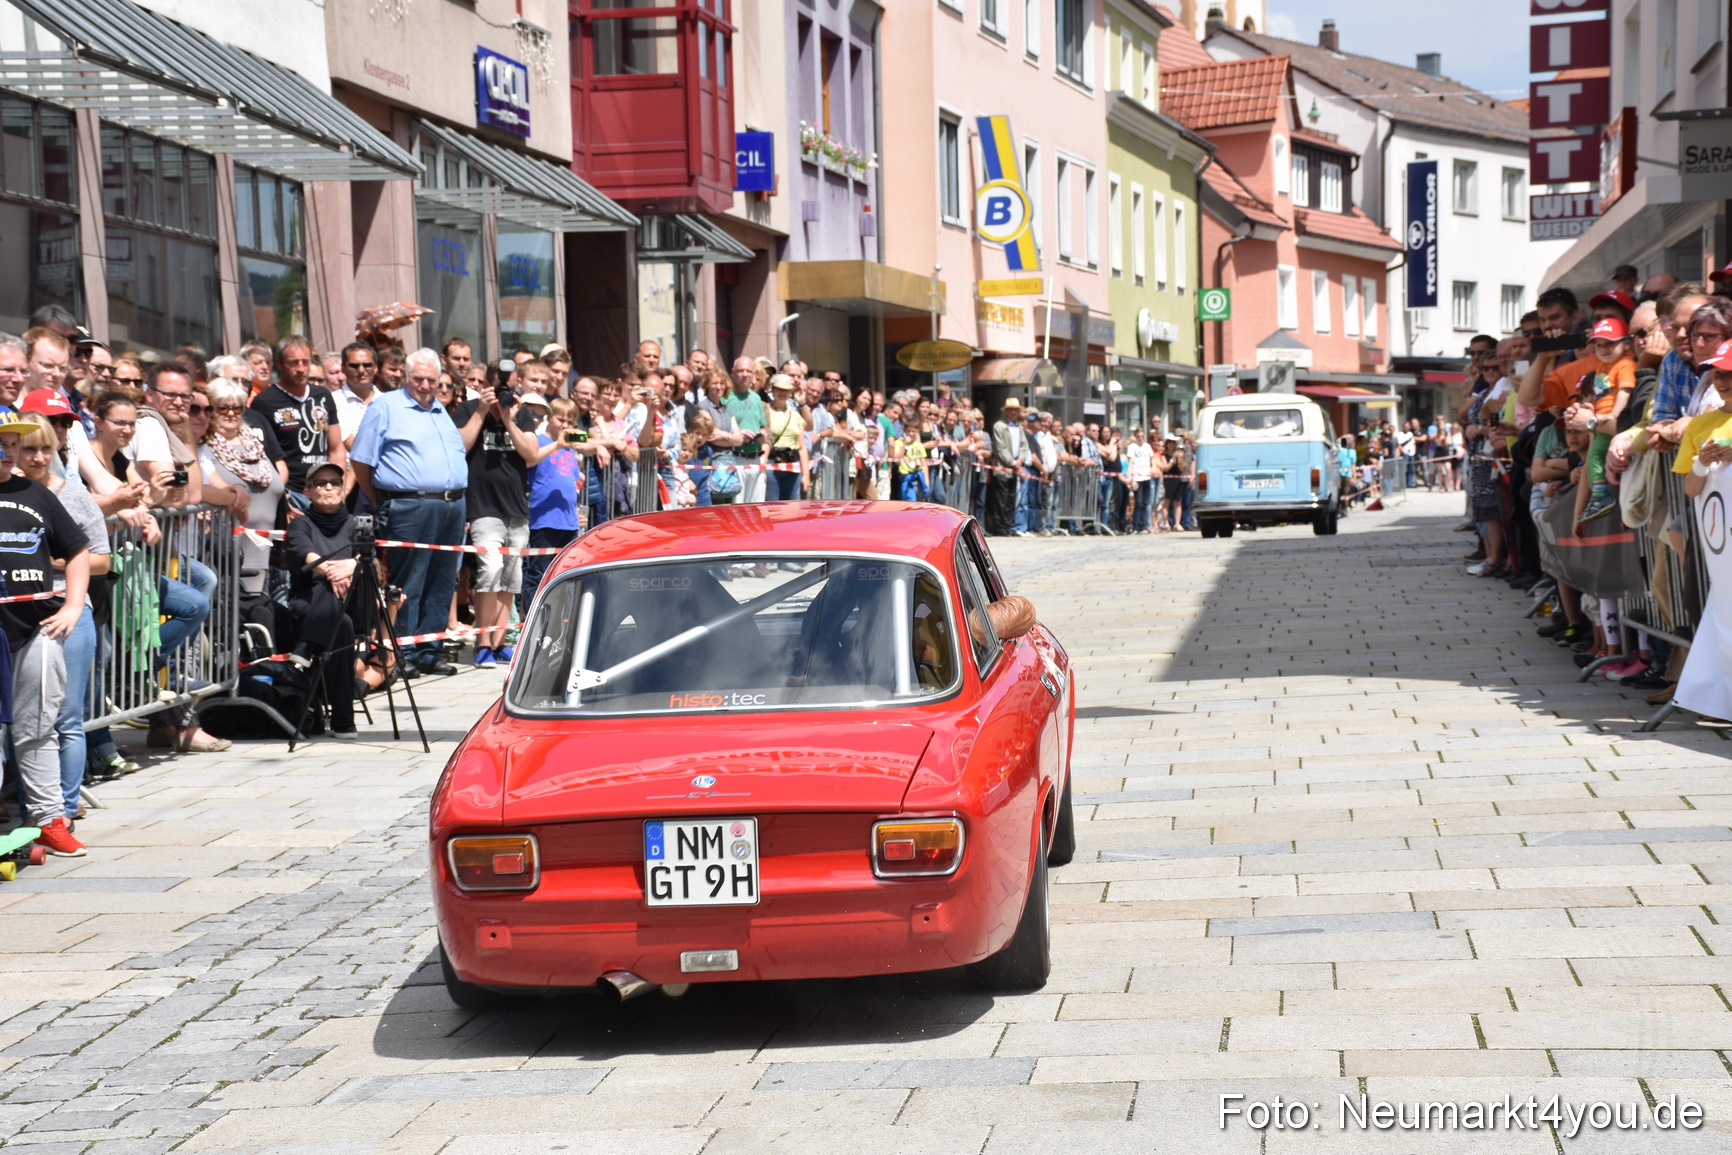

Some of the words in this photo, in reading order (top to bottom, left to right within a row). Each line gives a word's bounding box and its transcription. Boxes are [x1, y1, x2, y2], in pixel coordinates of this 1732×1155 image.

[363, 58, 405, 89] Klostergasse
[405, 74, 411, 91] 2
[485, 55, 530, 108] CECIL
[1534, 0, 1588, 179] ITT
[984, 196, 1012, 226] B
[1426, 172, 1436, 243] TAILOR
[433, 237, 470, 276] CECIL
[511, 255, 542, 290] CECIL
[1426, 245, 1436, 296] TOM
[18, 504, 44, 522] LOCAL
[629, 577, 692, 592] sparco
[669, 692, 766, 709] histo:tec
[651, 845, 660, 856] D
[677, 825, 724, 860] NM
[651, 865, 696, 900] GT
[705, 863, 754, 898] 9H
